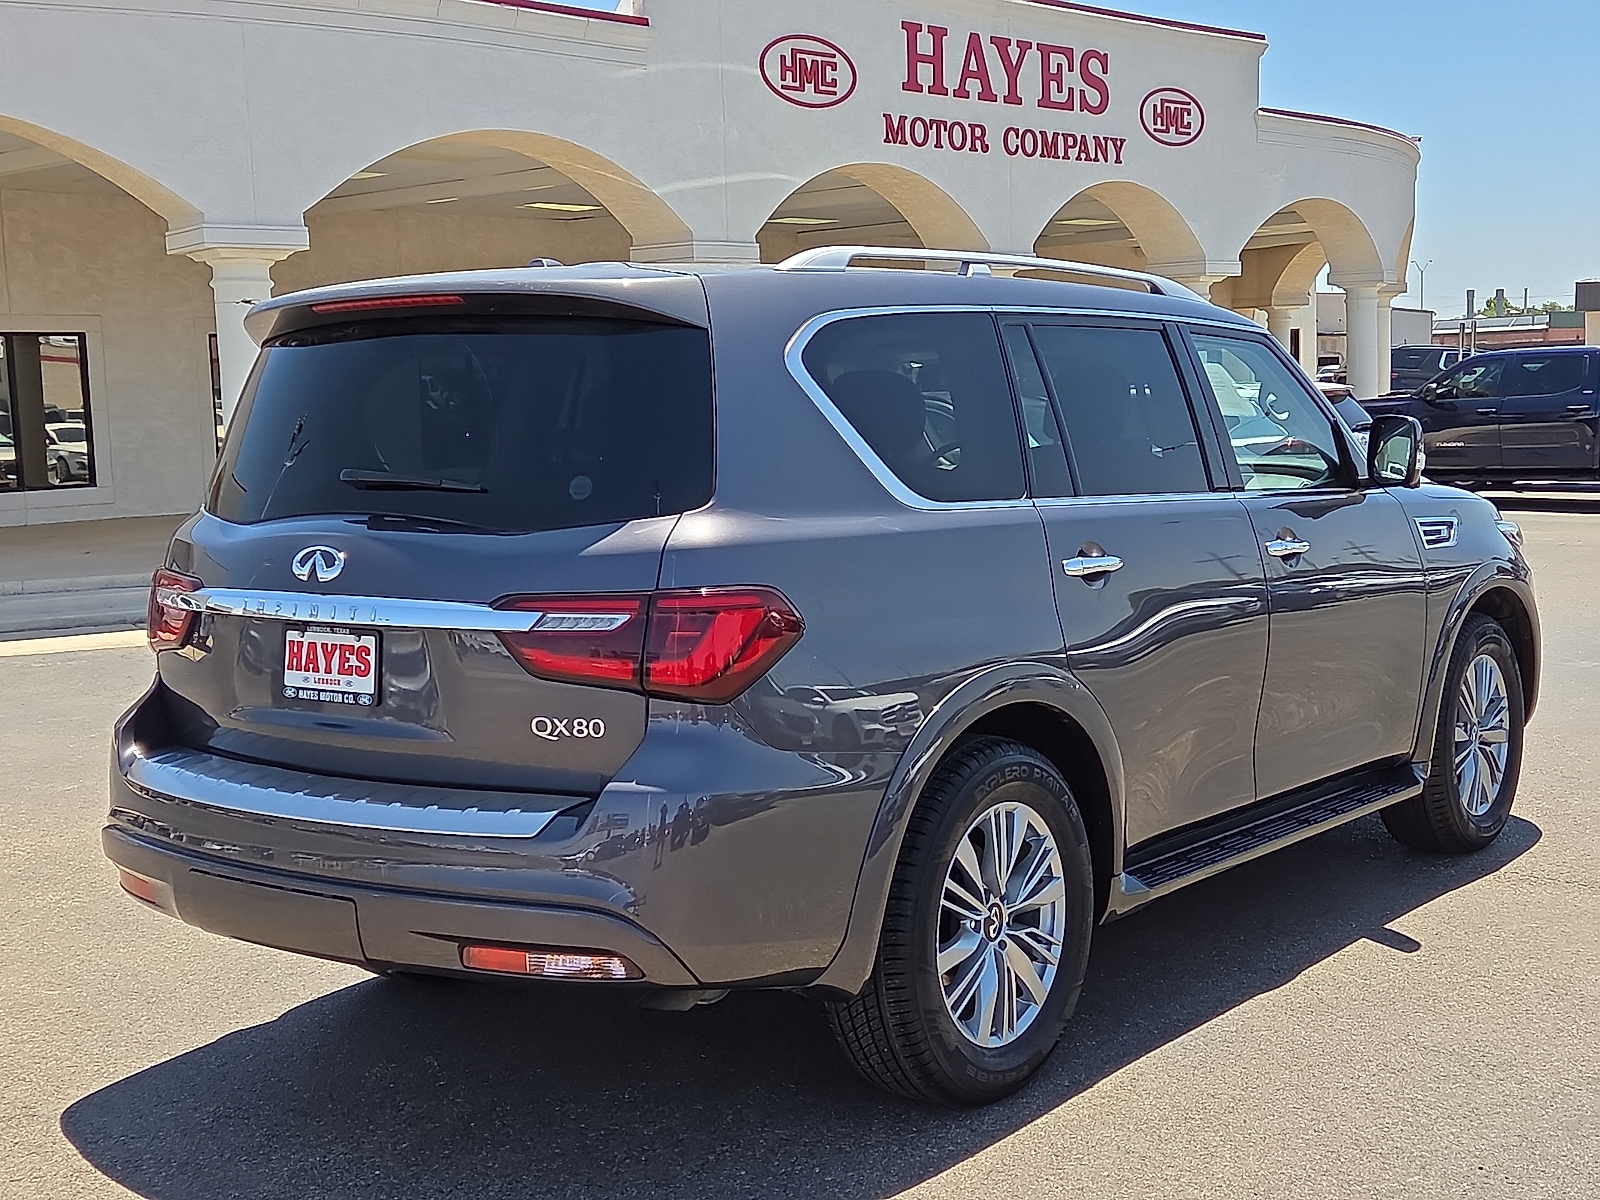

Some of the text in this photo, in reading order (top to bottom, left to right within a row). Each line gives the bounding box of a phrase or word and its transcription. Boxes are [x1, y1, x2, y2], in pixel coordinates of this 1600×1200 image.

[780, 47, 838, 96] HMC
[901, 20, 1110, 116] HAYES
[1153, 98, 1192, 136] HMC
[882, 112, 1127, 165] MOTOR COMPANY
[286, 639, 372, 678] HAYES
[298, 689, 319, 701] HAYES
[319, 691, 343, 703] MOTOR
[343, 693, 356, 704] CO.
[530, 716, 606, 741] QX80
[974, 765, 1030, 800] EXPLERO
